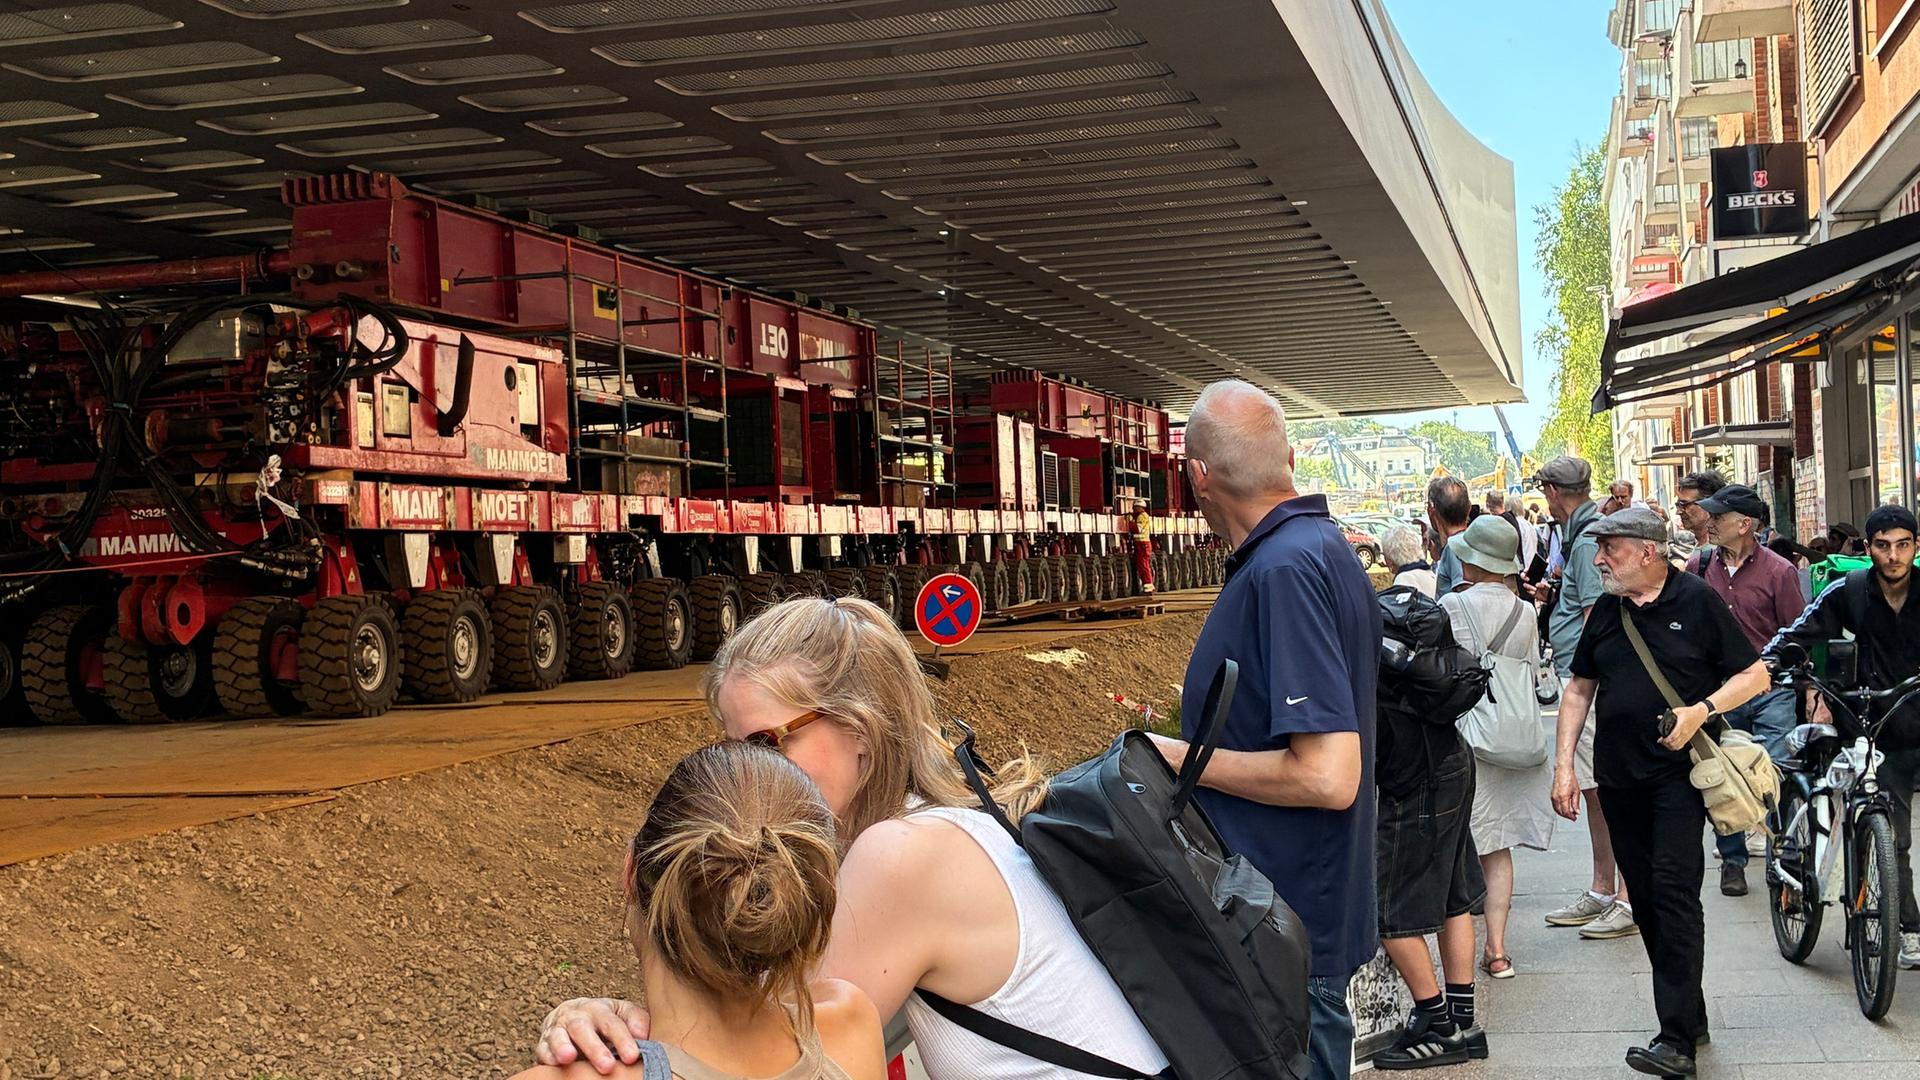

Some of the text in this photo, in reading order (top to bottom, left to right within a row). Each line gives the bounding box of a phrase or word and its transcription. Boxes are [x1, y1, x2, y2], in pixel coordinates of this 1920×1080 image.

[1728, 190, 1795, 208] BECK'S
[487, 447, 554, 472] MAMMOET
[391, 489, 527, 520] MAM MOET
